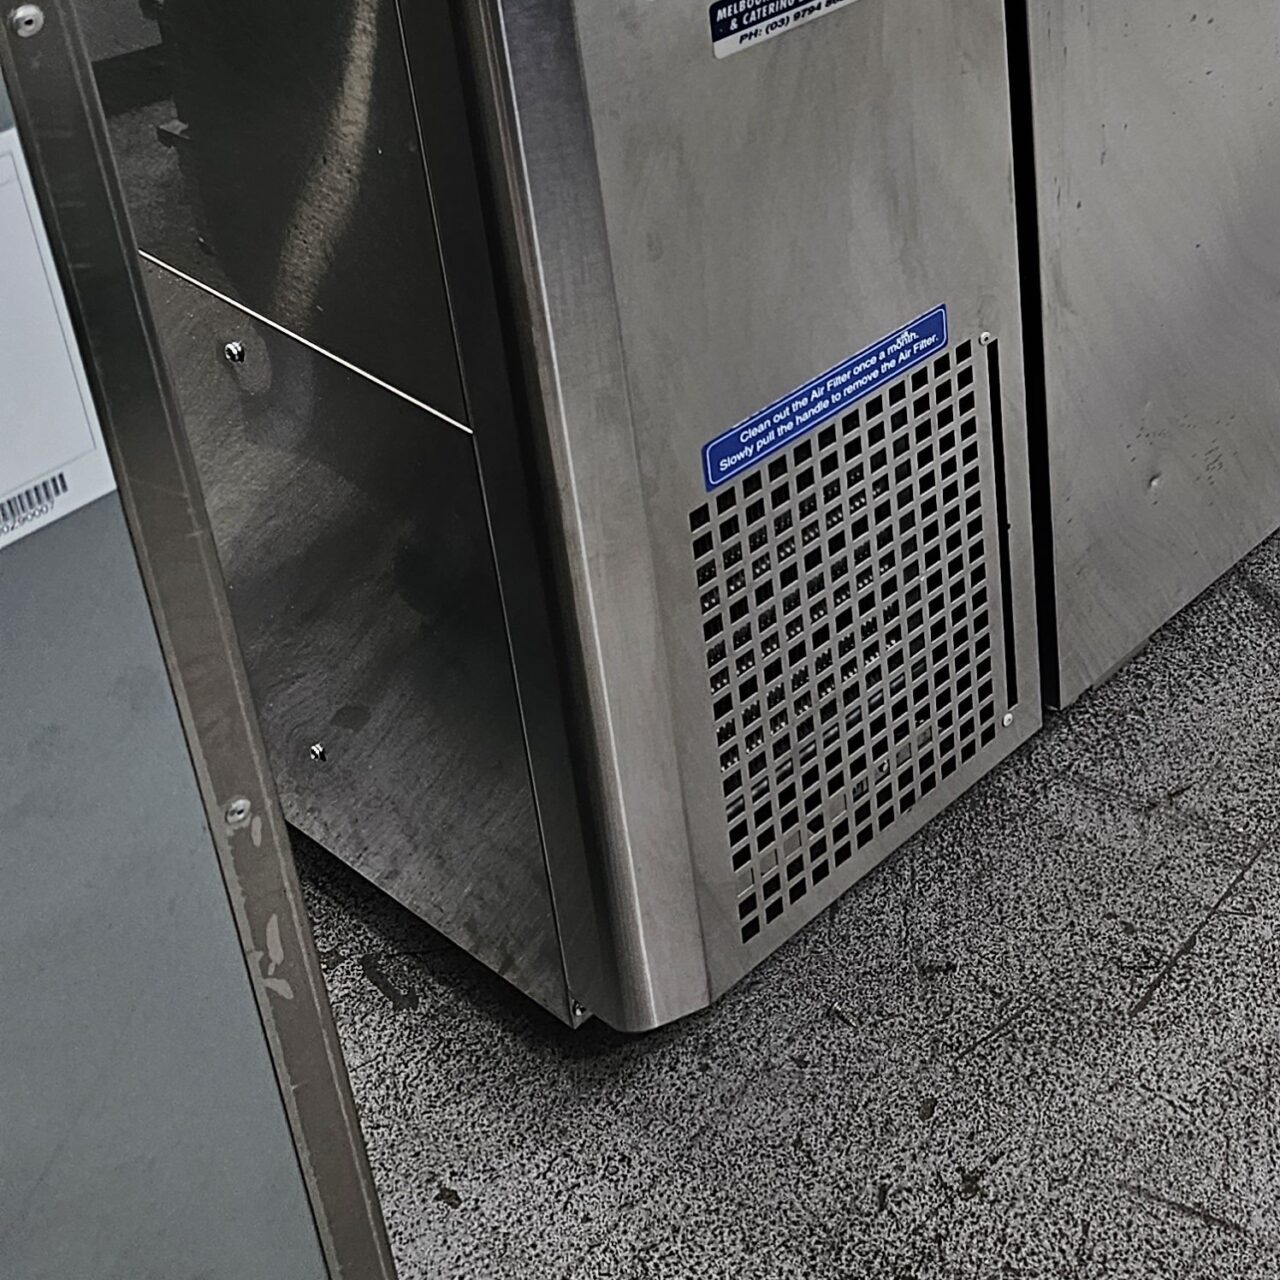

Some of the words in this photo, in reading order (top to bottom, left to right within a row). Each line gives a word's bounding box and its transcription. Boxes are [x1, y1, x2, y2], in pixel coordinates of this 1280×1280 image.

[730, 19, 738, 30] &
[739, 28, 762, 44] PH:
[765, 16, 790, 34] (03)
[719, 444, 754, 471] Slowly
[756, 430, 775, 452] pull
[777, 421, 794, 437] the
[795, 399, 829, 426] handle
[831, 393, 842, 404] to
[843, 369, 879, 396] remove
[881, 360, 896, 373] the
[898, 349, 911, 364] Air
[913, 334, 939, 353] Filter.
[740, 420, 771, 443] Clean
[773, 407, 790, 423] out
[791, 397, 808, 412] the
[810, 386, 825, 401] Air
[826, 370, 852, 391] Filter
[853, 356, 877, 375] once
[879, 351, 885, 360] a
[887, 332, 919, 355] month.
